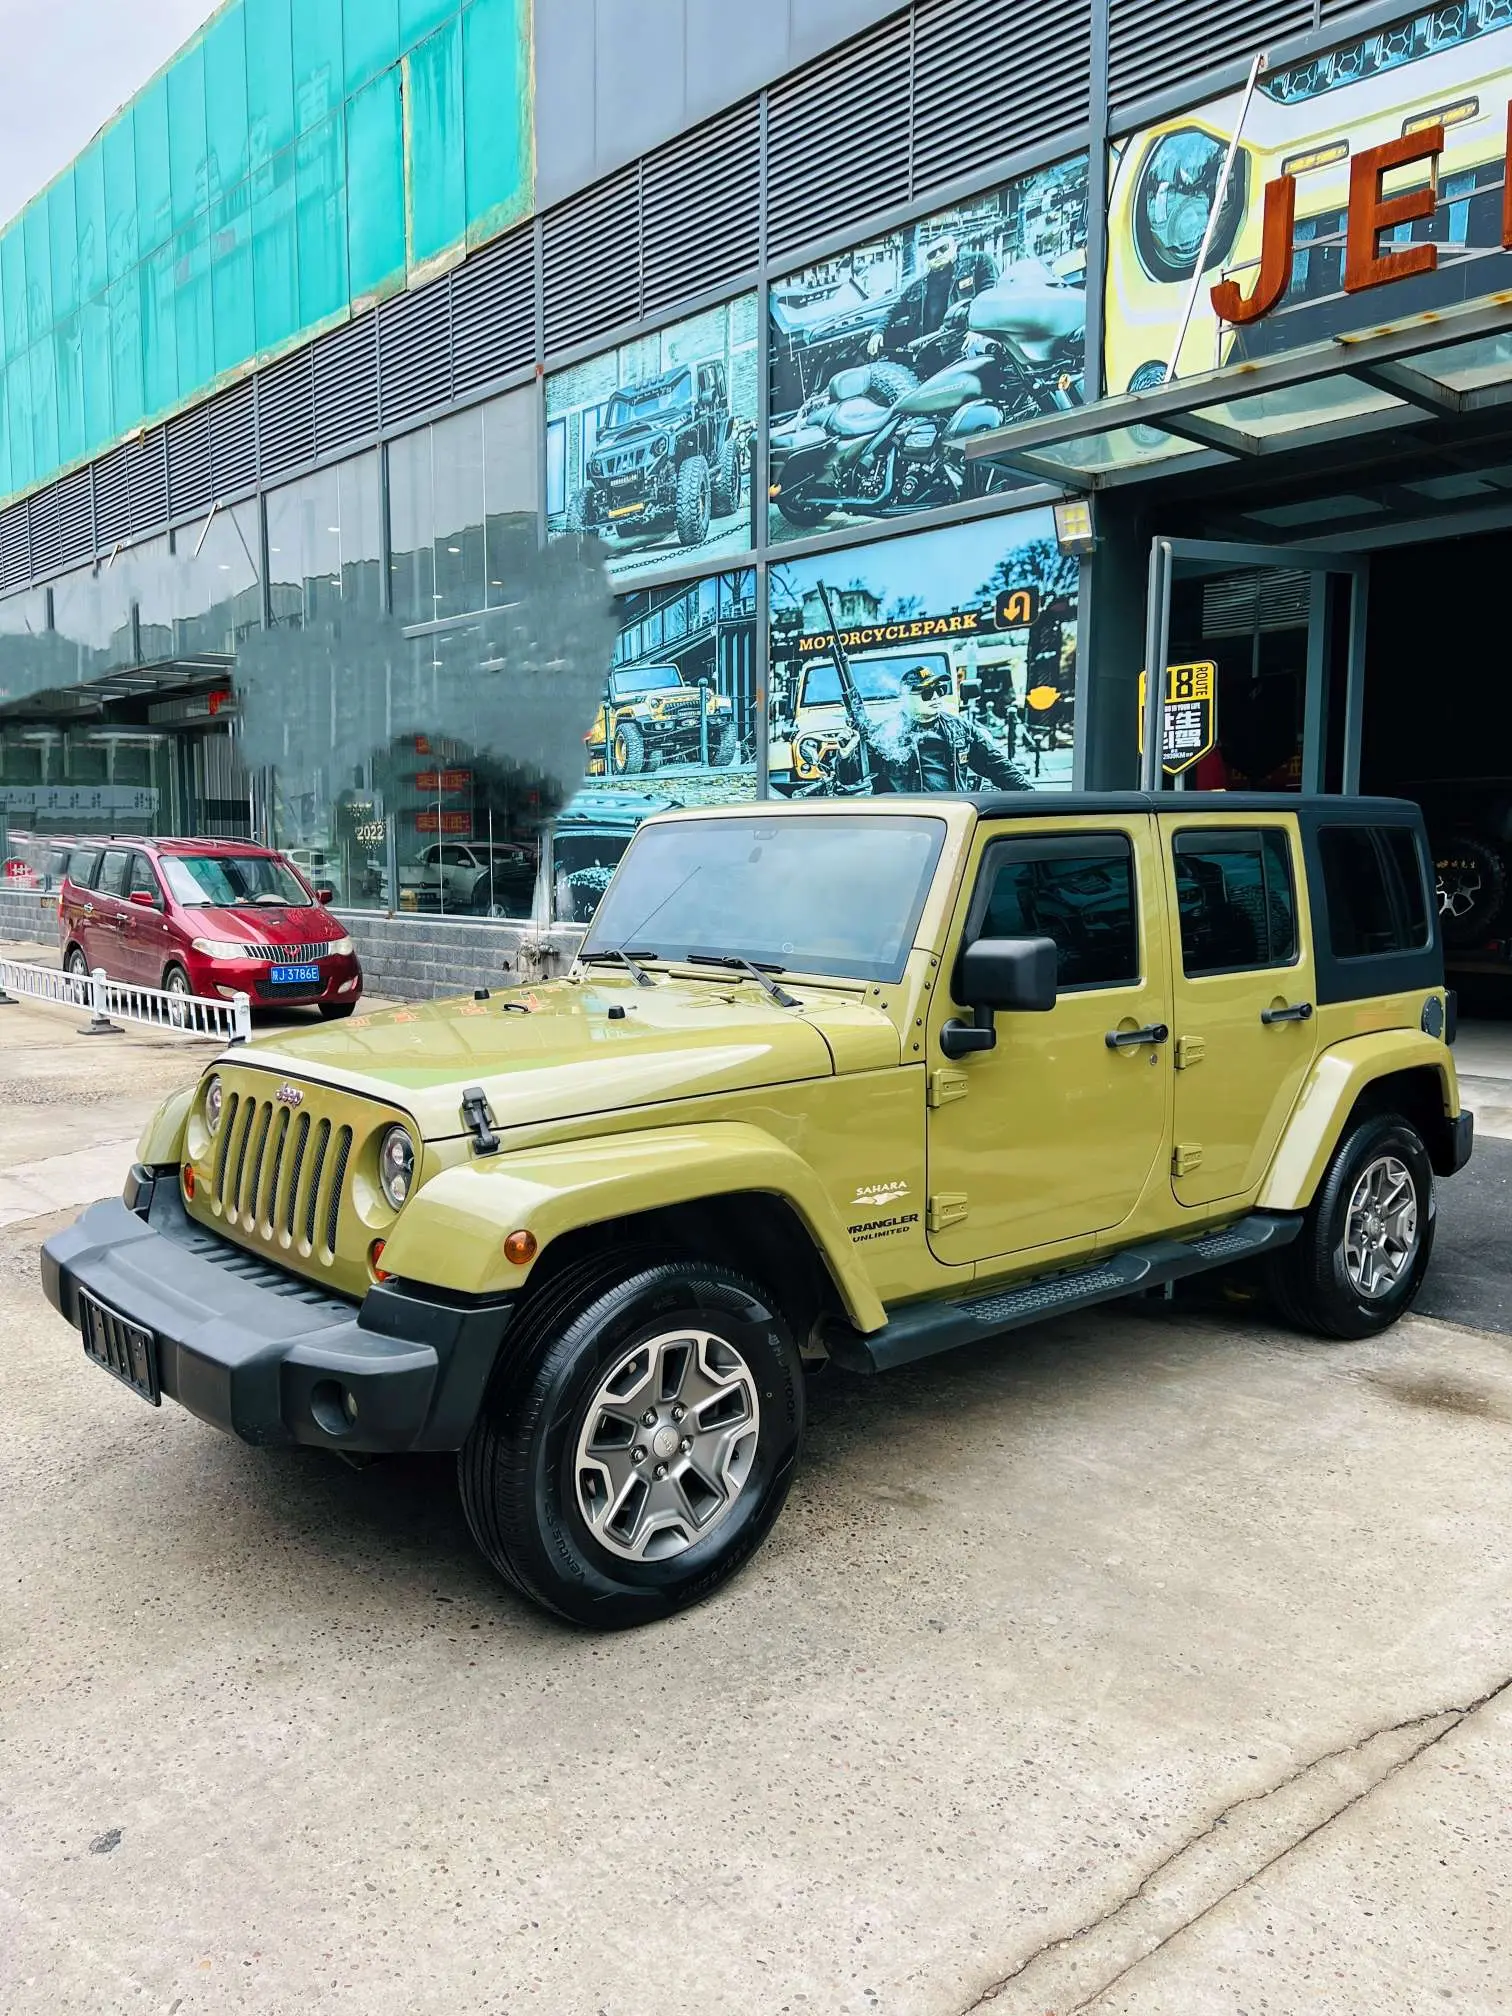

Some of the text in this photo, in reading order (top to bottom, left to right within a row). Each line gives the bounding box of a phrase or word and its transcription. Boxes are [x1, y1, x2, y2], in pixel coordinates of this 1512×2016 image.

[799, 613, 978, 651] MOTORCYCLEPARK
[1195, 666, 1209, 696] ROUTE
[355, 824, 384, 840] 2022
[287, 967, 318, 980] 3786E
[856, 1180, 907, 1196] SAHARA
[852, 1226, 910, 1243] UNLIMITED
